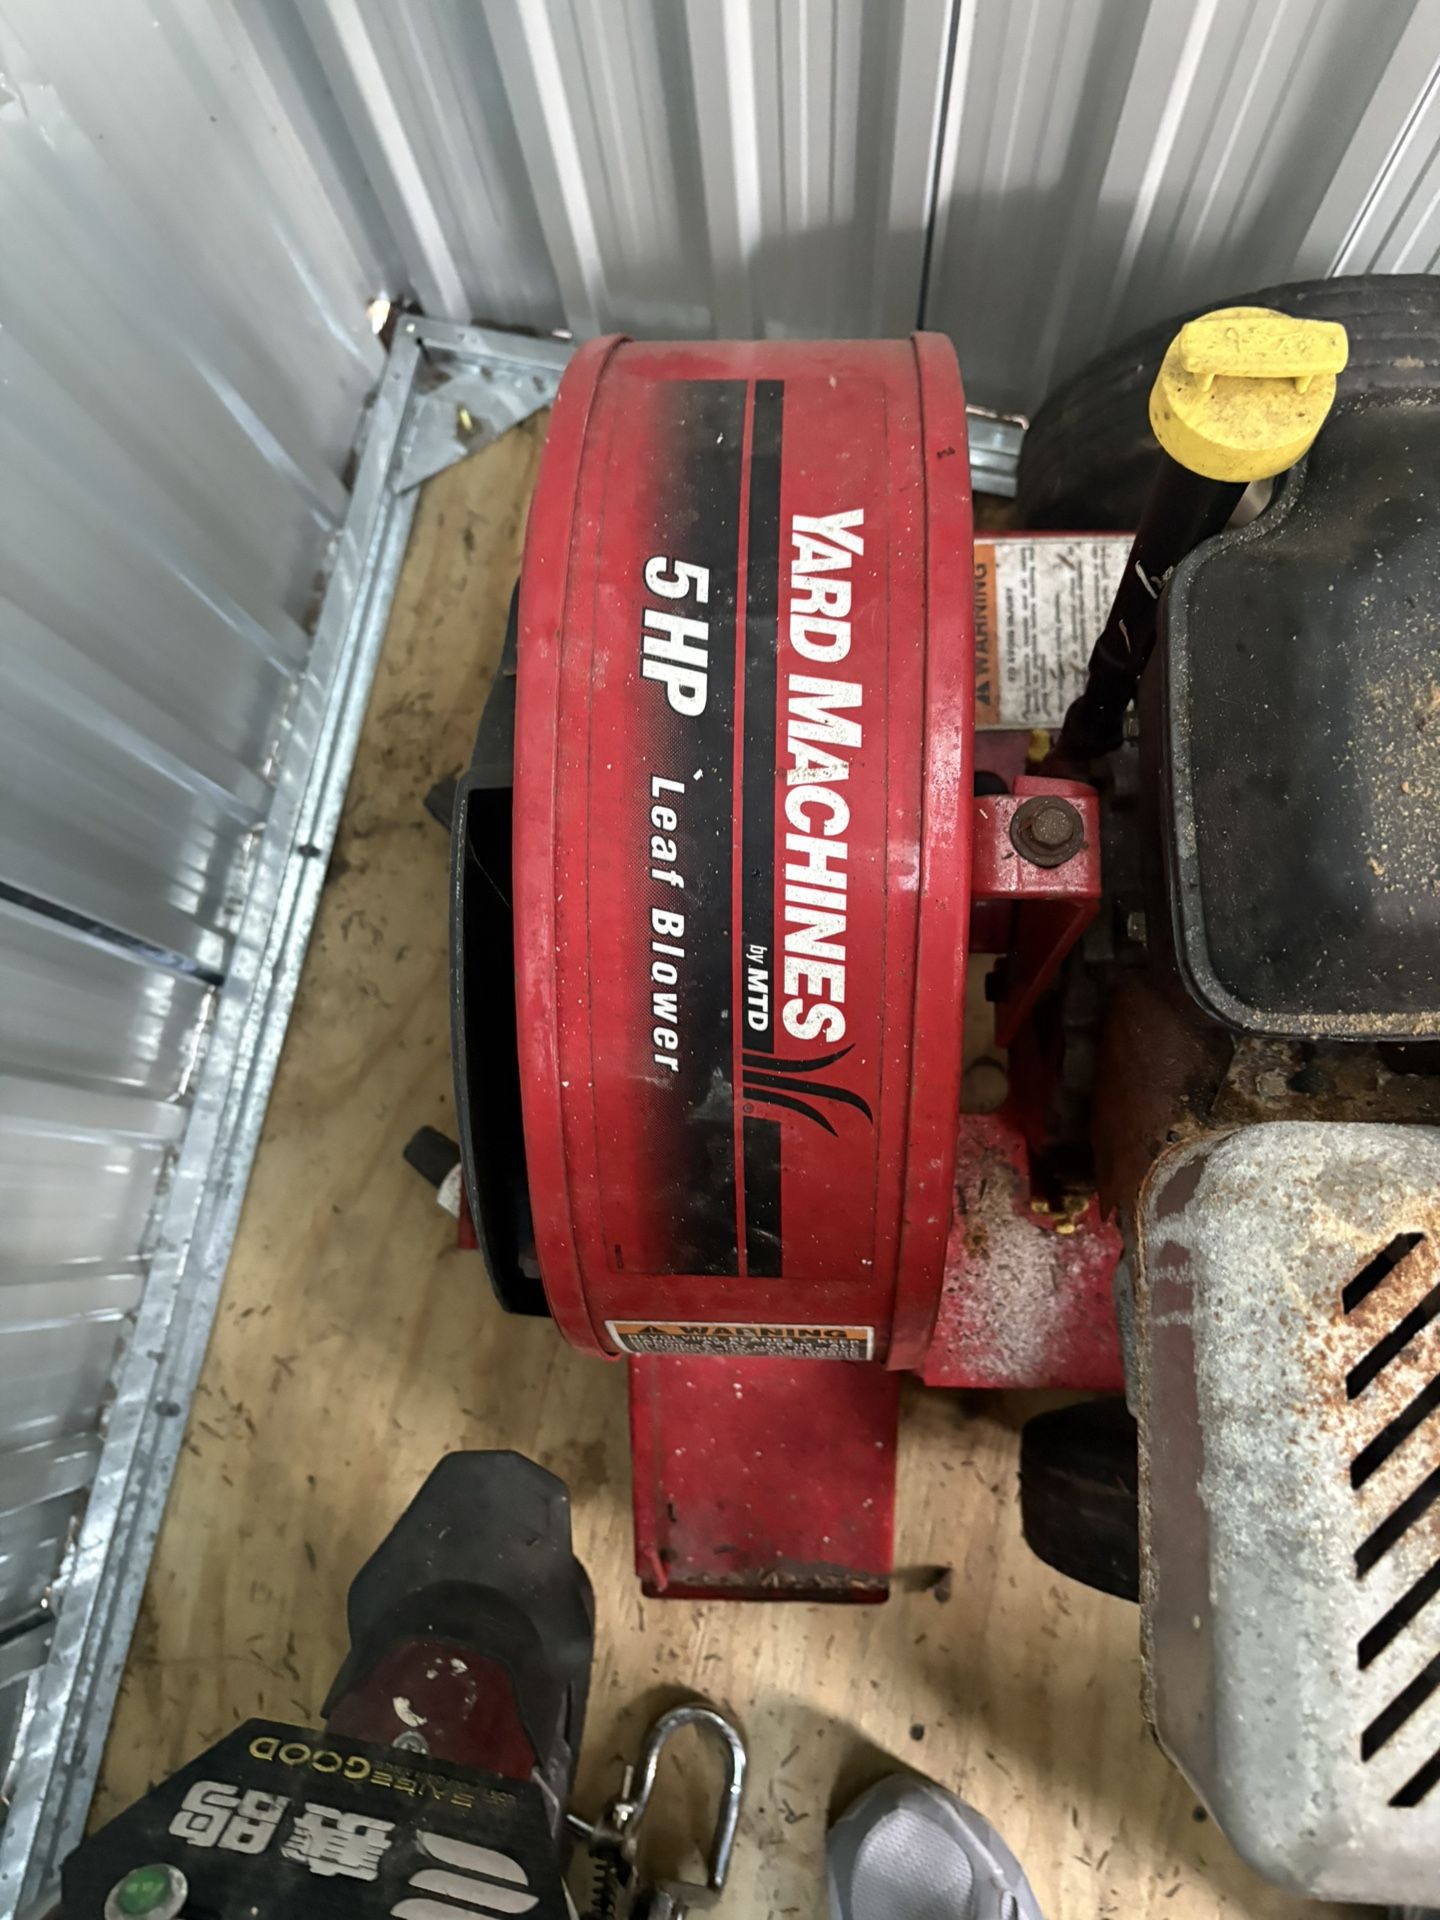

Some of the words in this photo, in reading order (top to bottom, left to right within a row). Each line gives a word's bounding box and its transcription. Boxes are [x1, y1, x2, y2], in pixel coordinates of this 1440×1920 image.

[643, 556, 710, 604] 5
[789, 508, 864, 663] YARD
[642, 608, 709, 718] HP
[651, 775, 685, 889] Leaf
[782, 673, 863, 1043] MACHINES
[651, 907, 685, 1073] Blower
[746, 944, 767, 965] by
[748, 965, 769, 1032] MTD
[679, 1326, 848, 1338] WARNING
